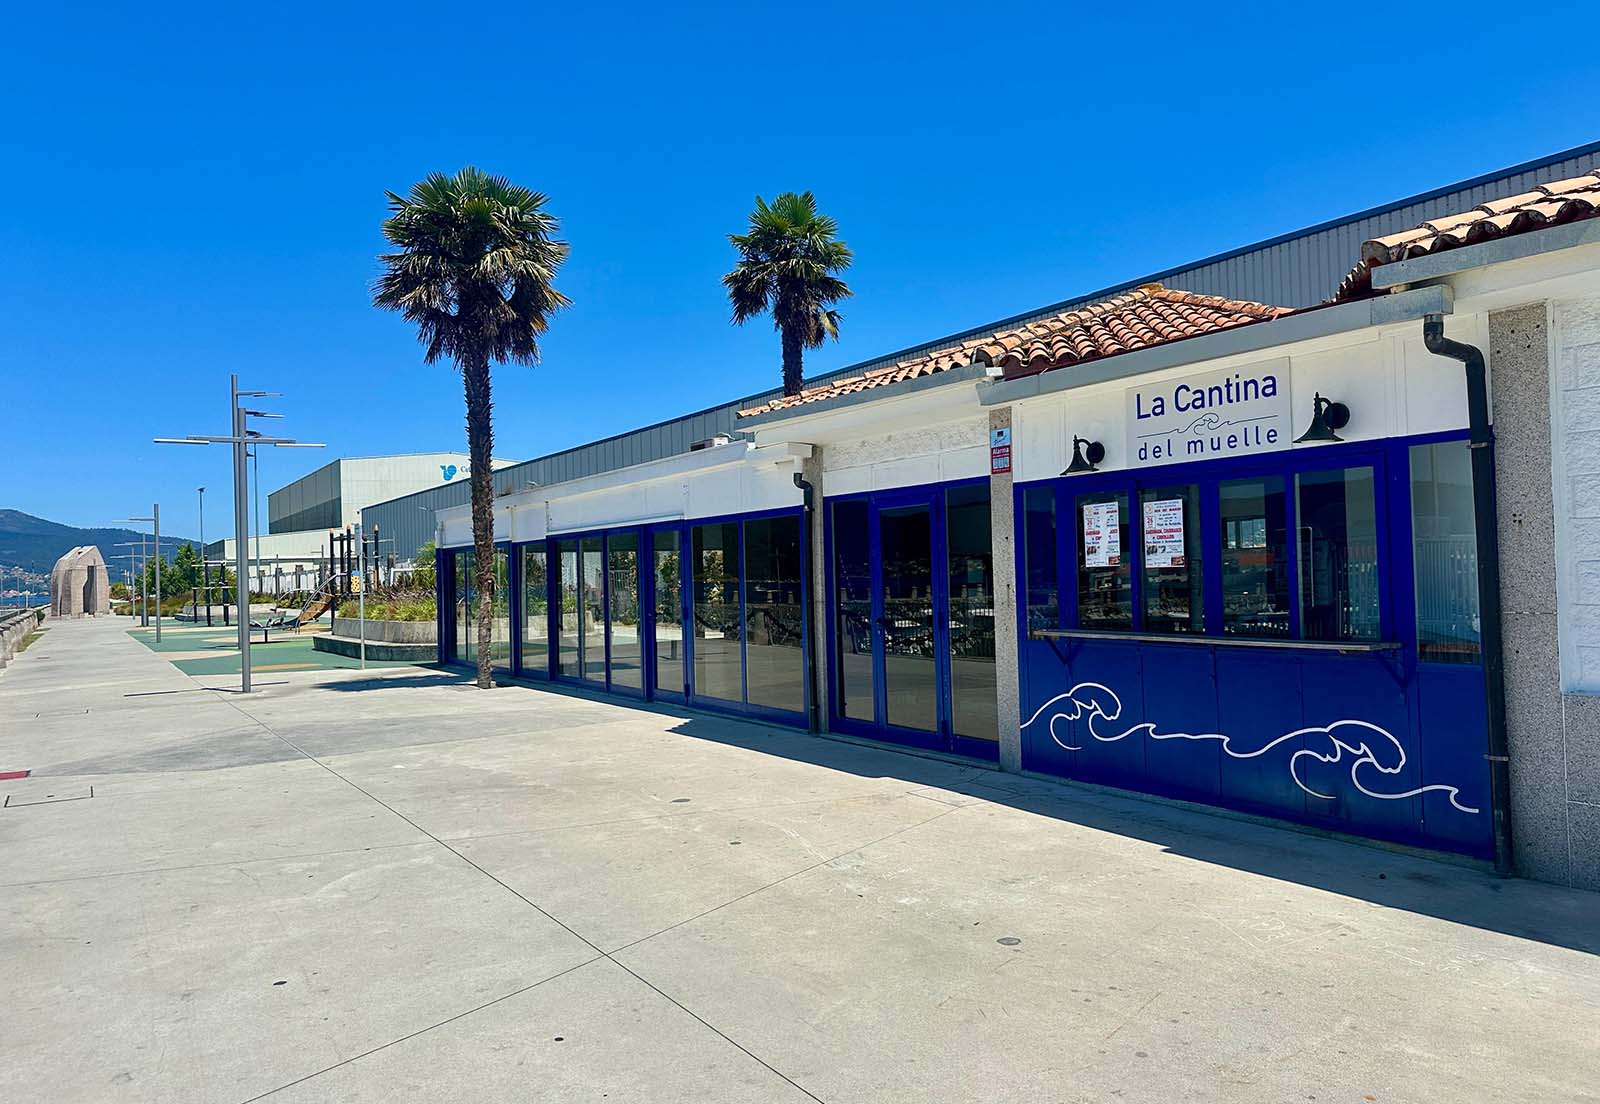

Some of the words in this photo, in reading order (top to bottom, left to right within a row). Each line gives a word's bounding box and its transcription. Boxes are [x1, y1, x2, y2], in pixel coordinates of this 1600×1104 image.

[1136, 393, 1165, 419] La
[1174, 374, 1277, 412] Cantina
[1138, 438, 1172, 460] del
[1187, 425, 1278, 454] muelle
